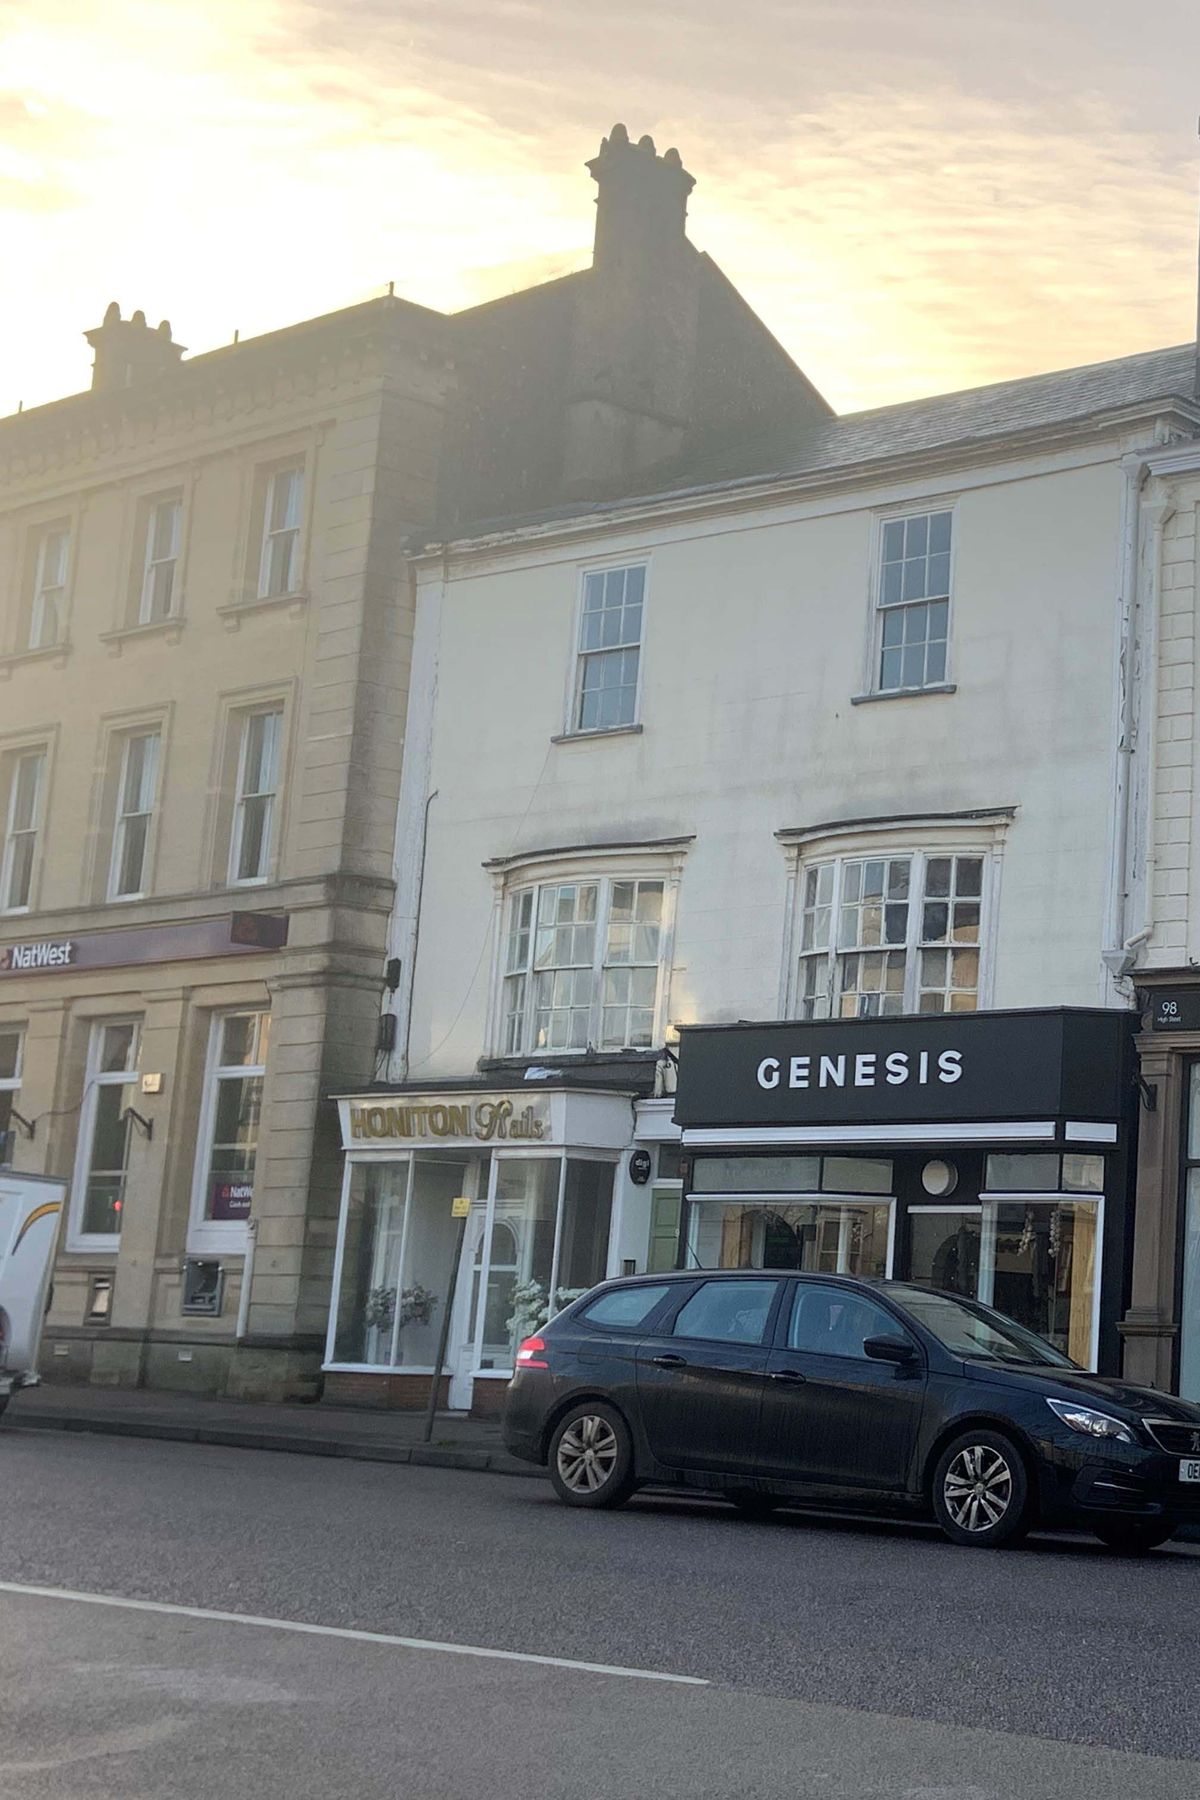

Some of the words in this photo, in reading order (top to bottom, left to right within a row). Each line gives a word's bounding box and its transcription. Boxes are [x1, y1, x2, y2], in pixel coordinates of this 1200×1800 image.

[11, 940, 72, 969] NatWest
[1162, 1001, 1177, 1015] 98
[757, 1050, 963, 1090] GENESIS
[350, 1105, 472, 1139] HONITON
